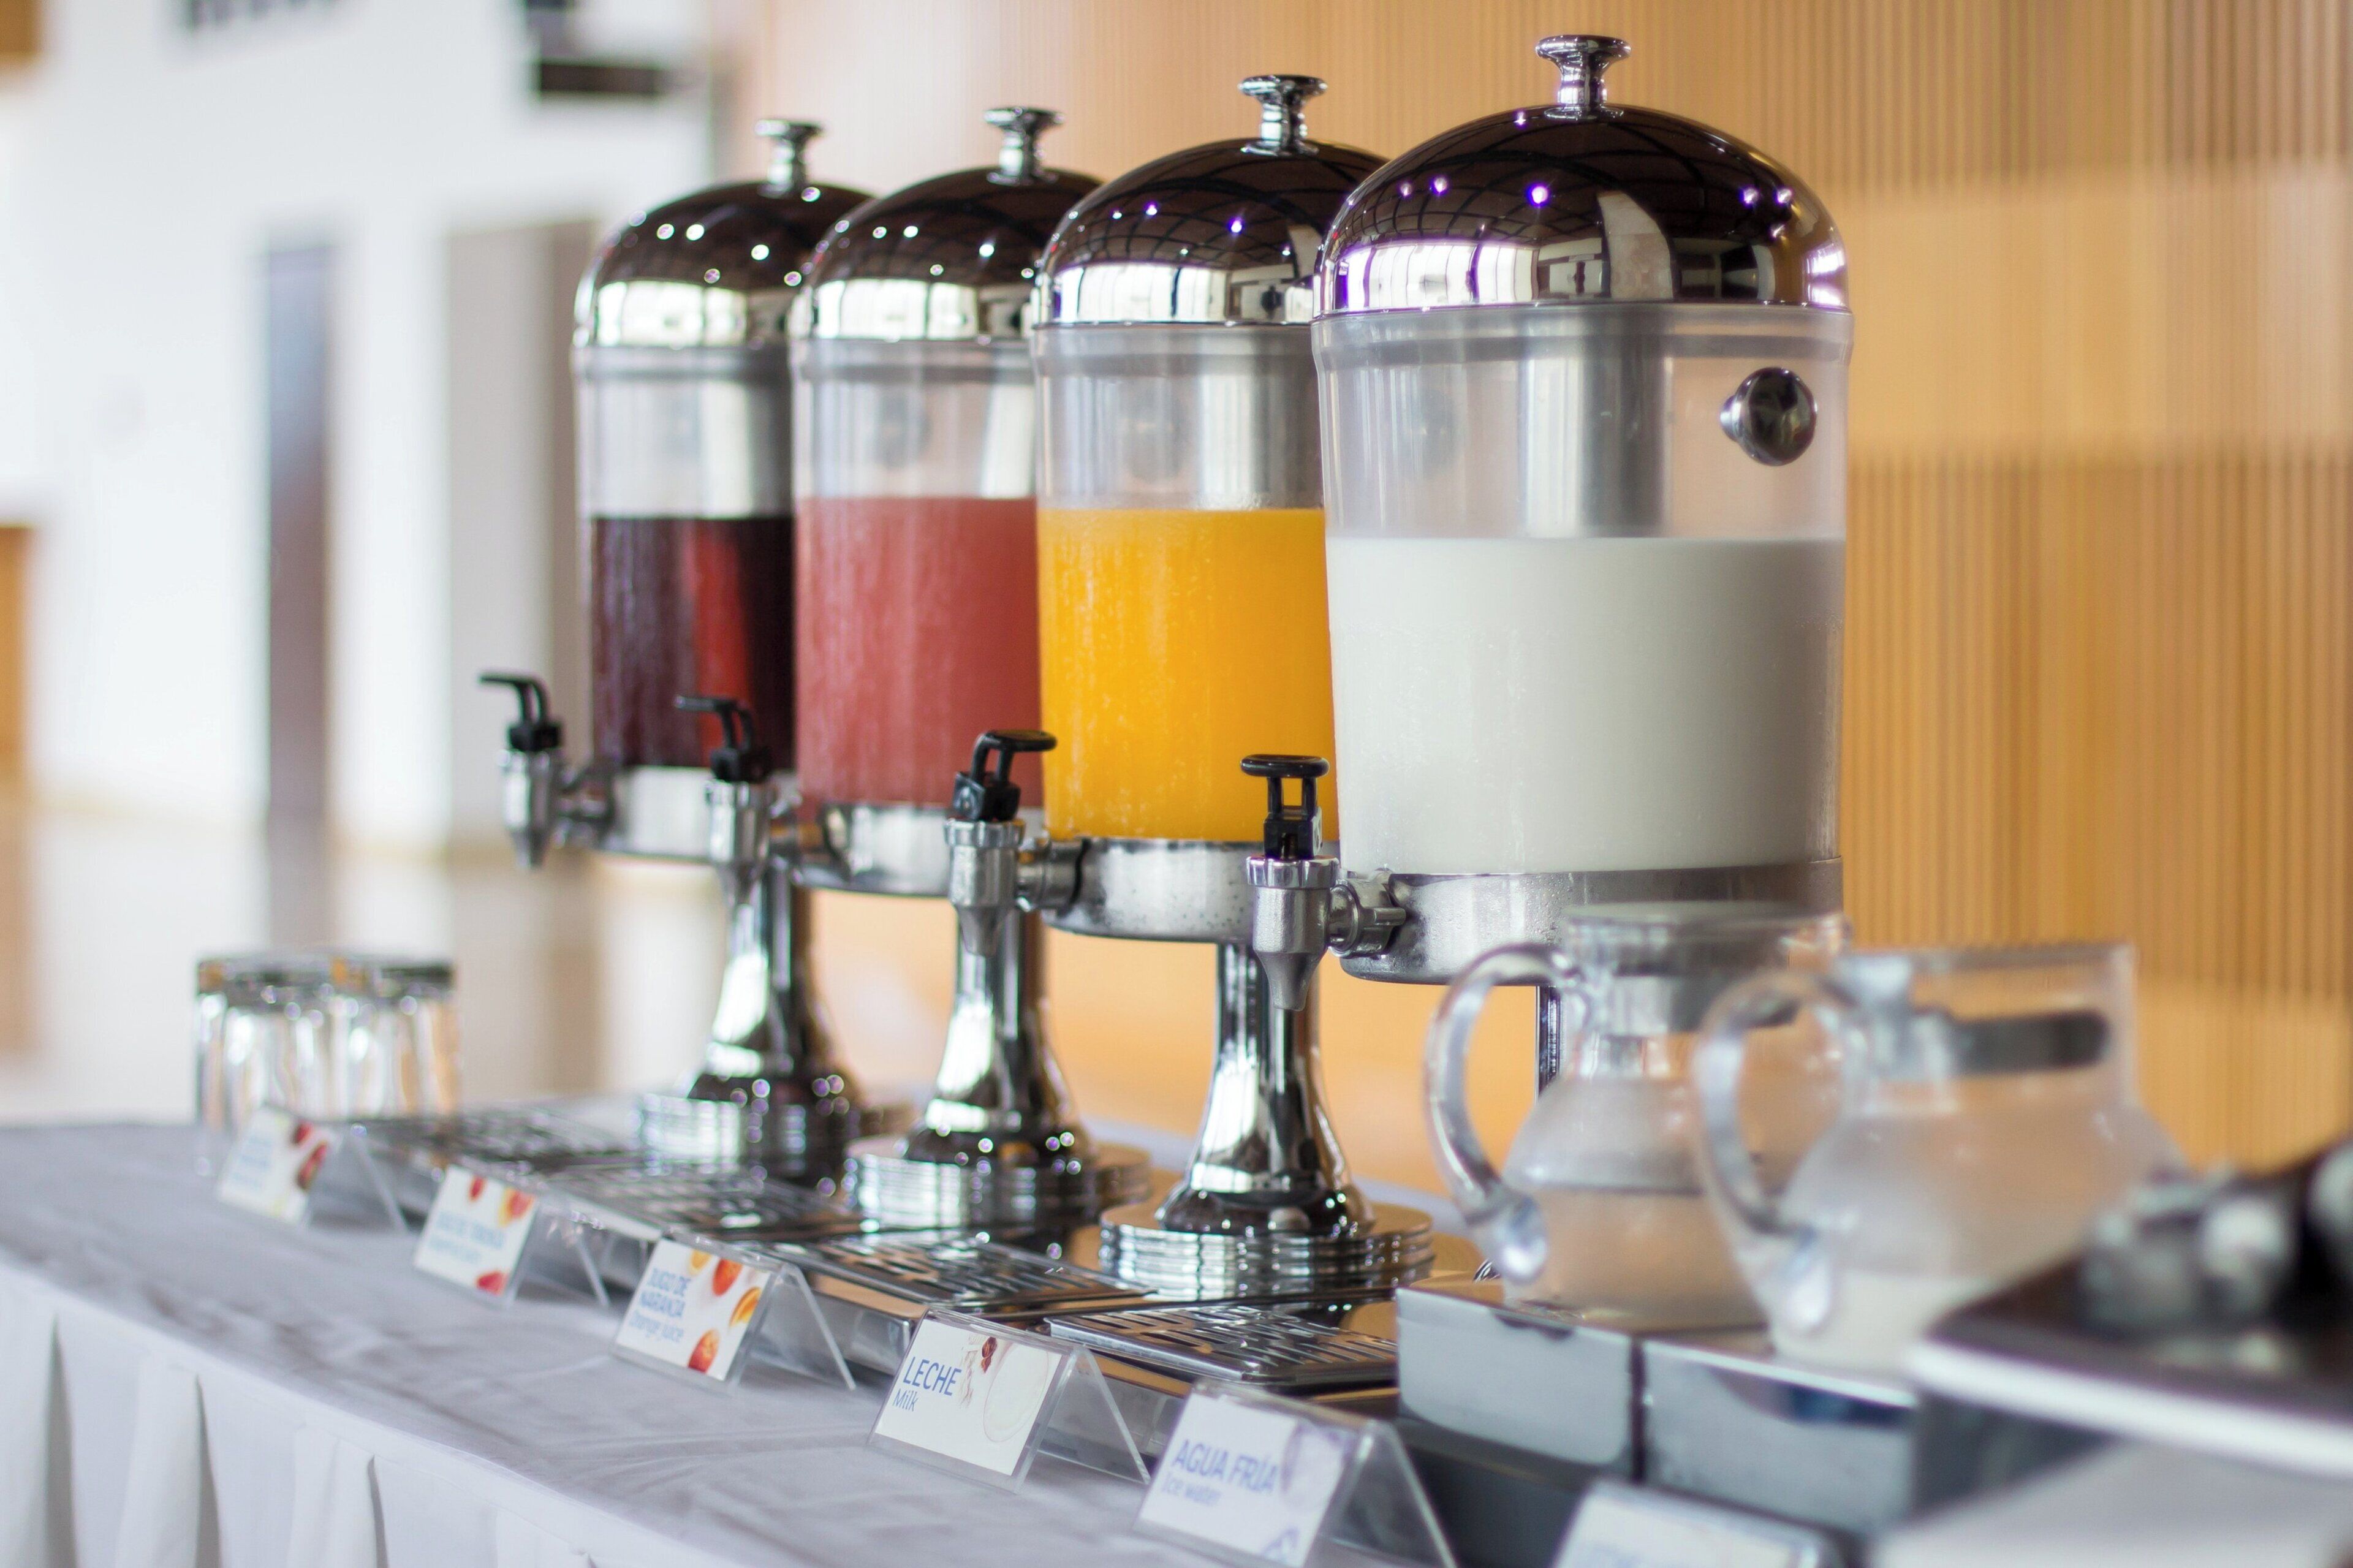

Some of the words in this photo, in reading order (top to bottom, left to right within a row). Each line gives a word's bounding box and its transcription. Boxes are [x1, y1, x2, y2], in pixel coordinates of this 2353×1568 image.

[903, 1356, 962, 1396] LECHE
[892, 1388, 919, 1412] Milk
[1172, 1439, 1229, 1482] AGUA
